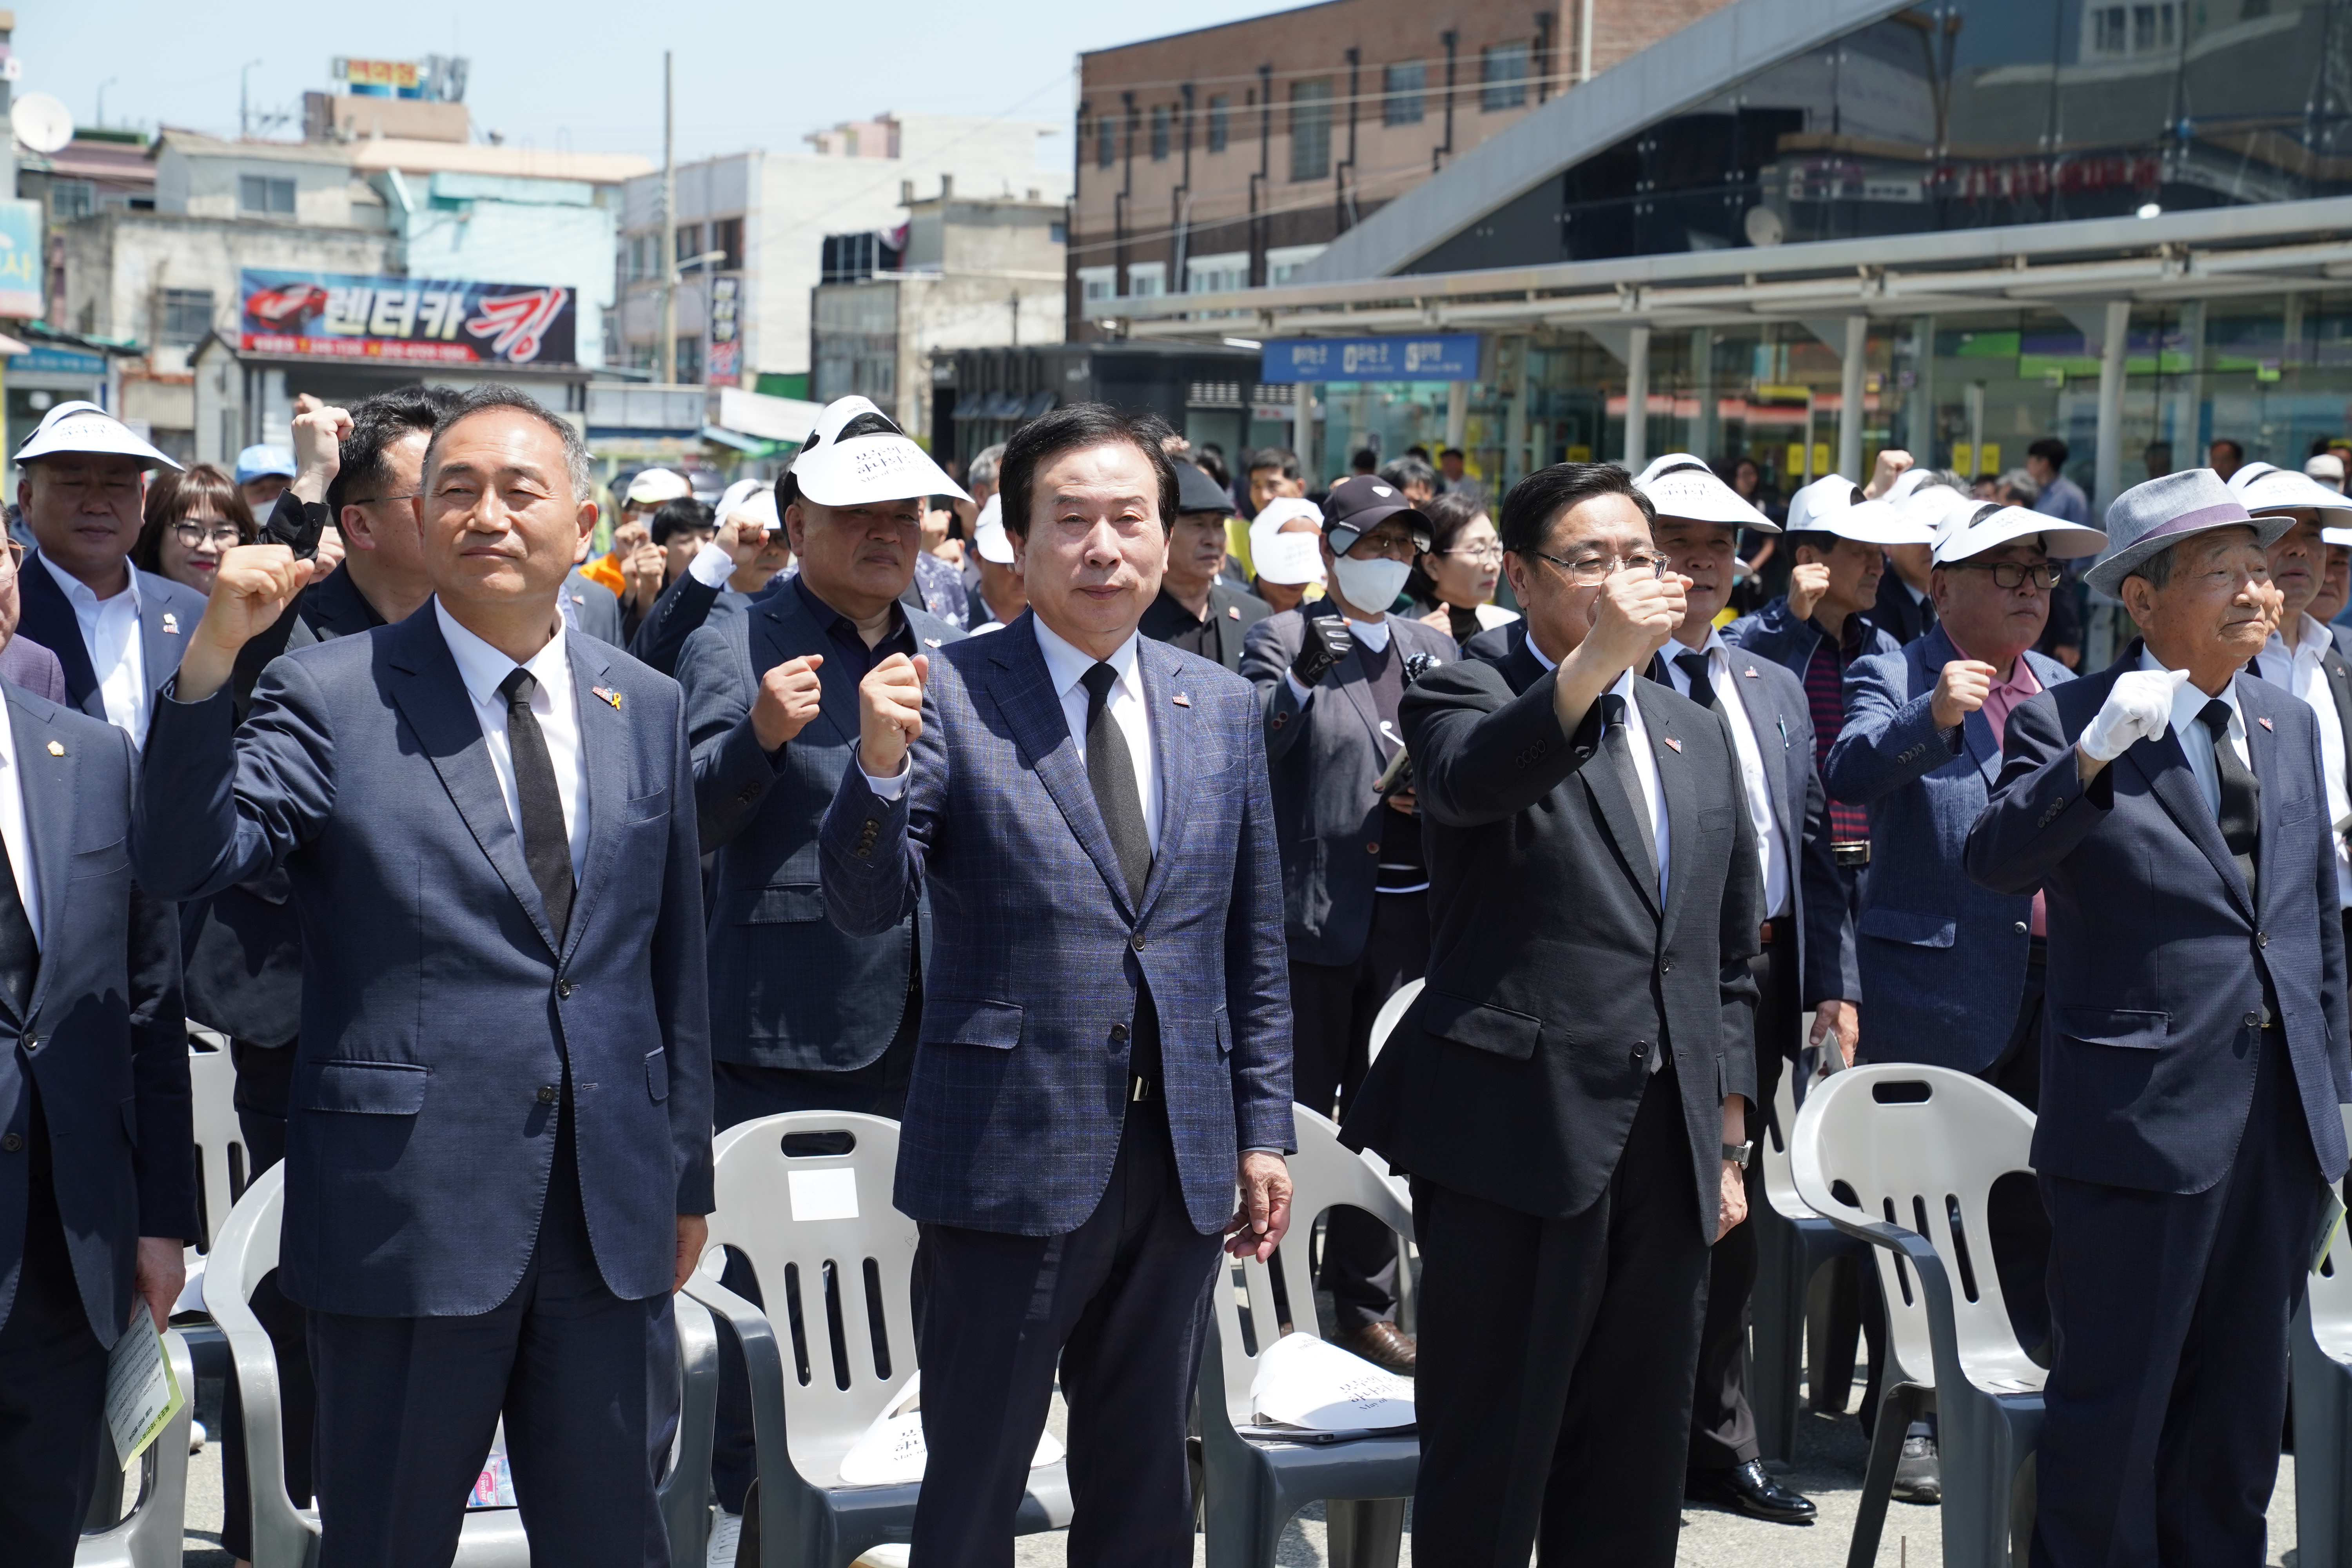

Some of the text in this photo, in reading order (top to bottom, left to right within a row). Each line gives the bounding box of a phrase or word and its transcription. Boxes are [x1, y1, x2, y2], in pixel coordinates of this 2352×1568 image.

[324, 287, 467, 341] 렌터카
[855, 446, 901, 464] 모두의
[1339, 1376, 1383, 1393] 모두의
[1358, 1401, 1379, 1411] May
[893, 1454, 912, 1463] May
